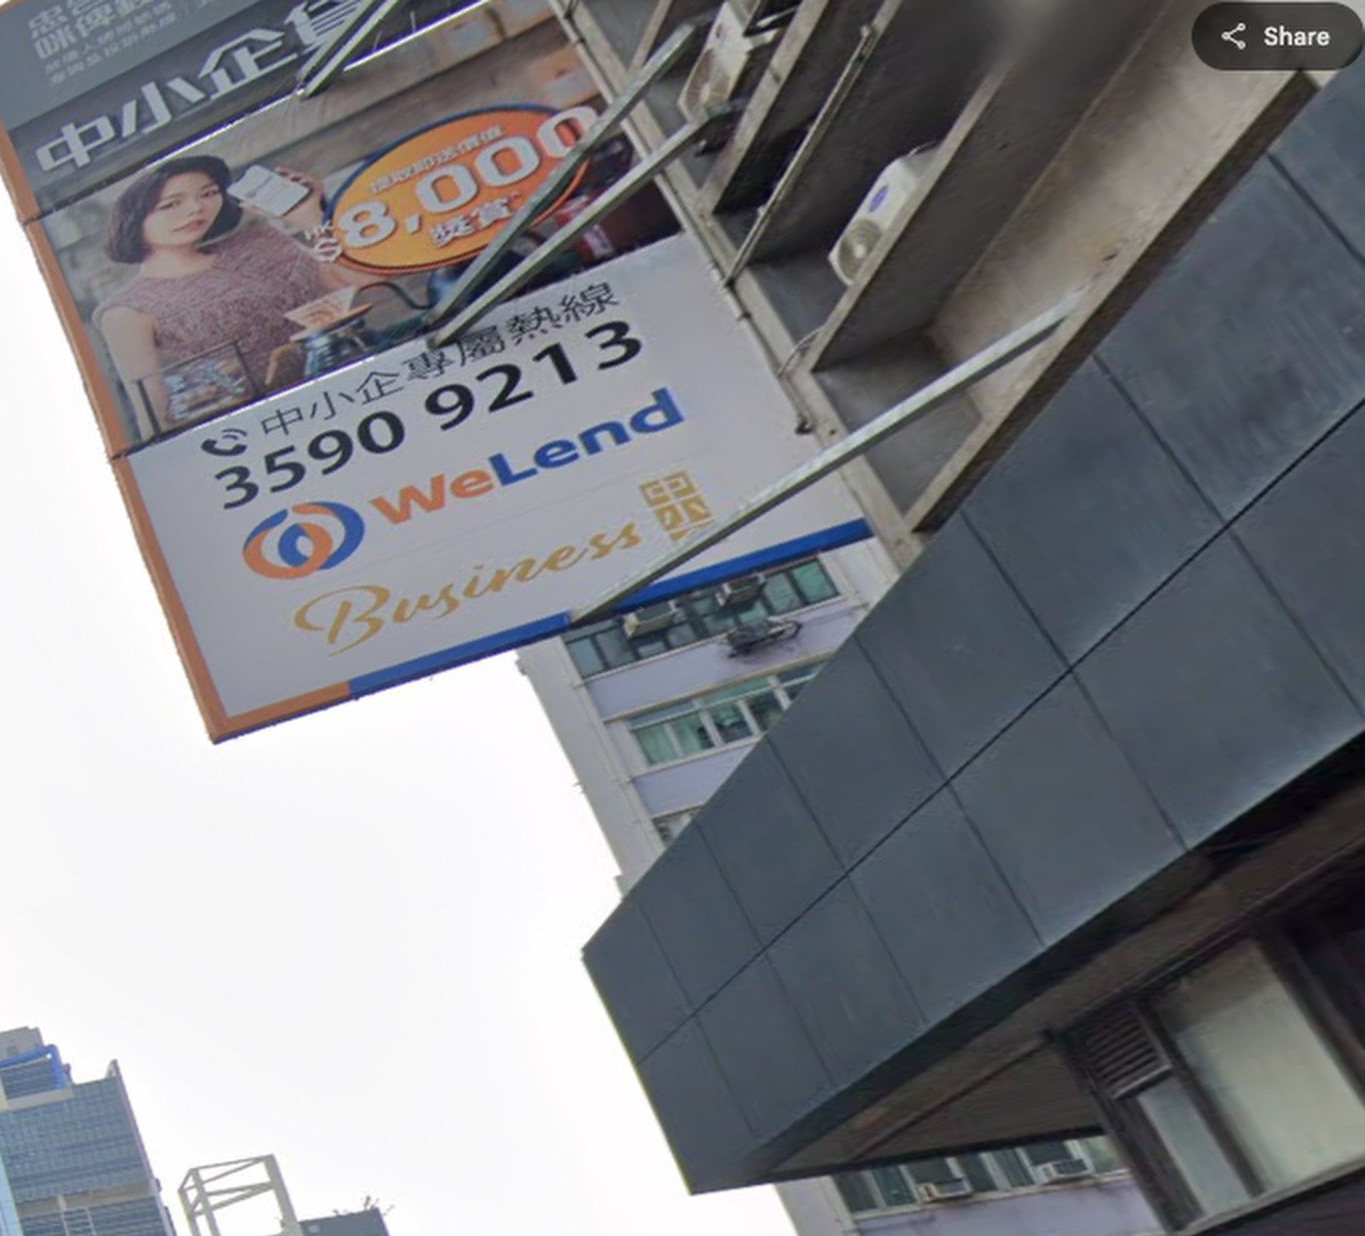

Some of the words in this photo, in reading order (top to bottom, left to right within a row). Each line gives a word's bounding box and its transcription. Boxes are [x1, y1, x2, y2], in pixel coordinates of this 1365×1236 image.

[212, 411, 405, 511] 3590
[423, 318, 644, 432] 9213
[370, 387, 685, 525] WeLend
[291, 519, 646, 657] Business
